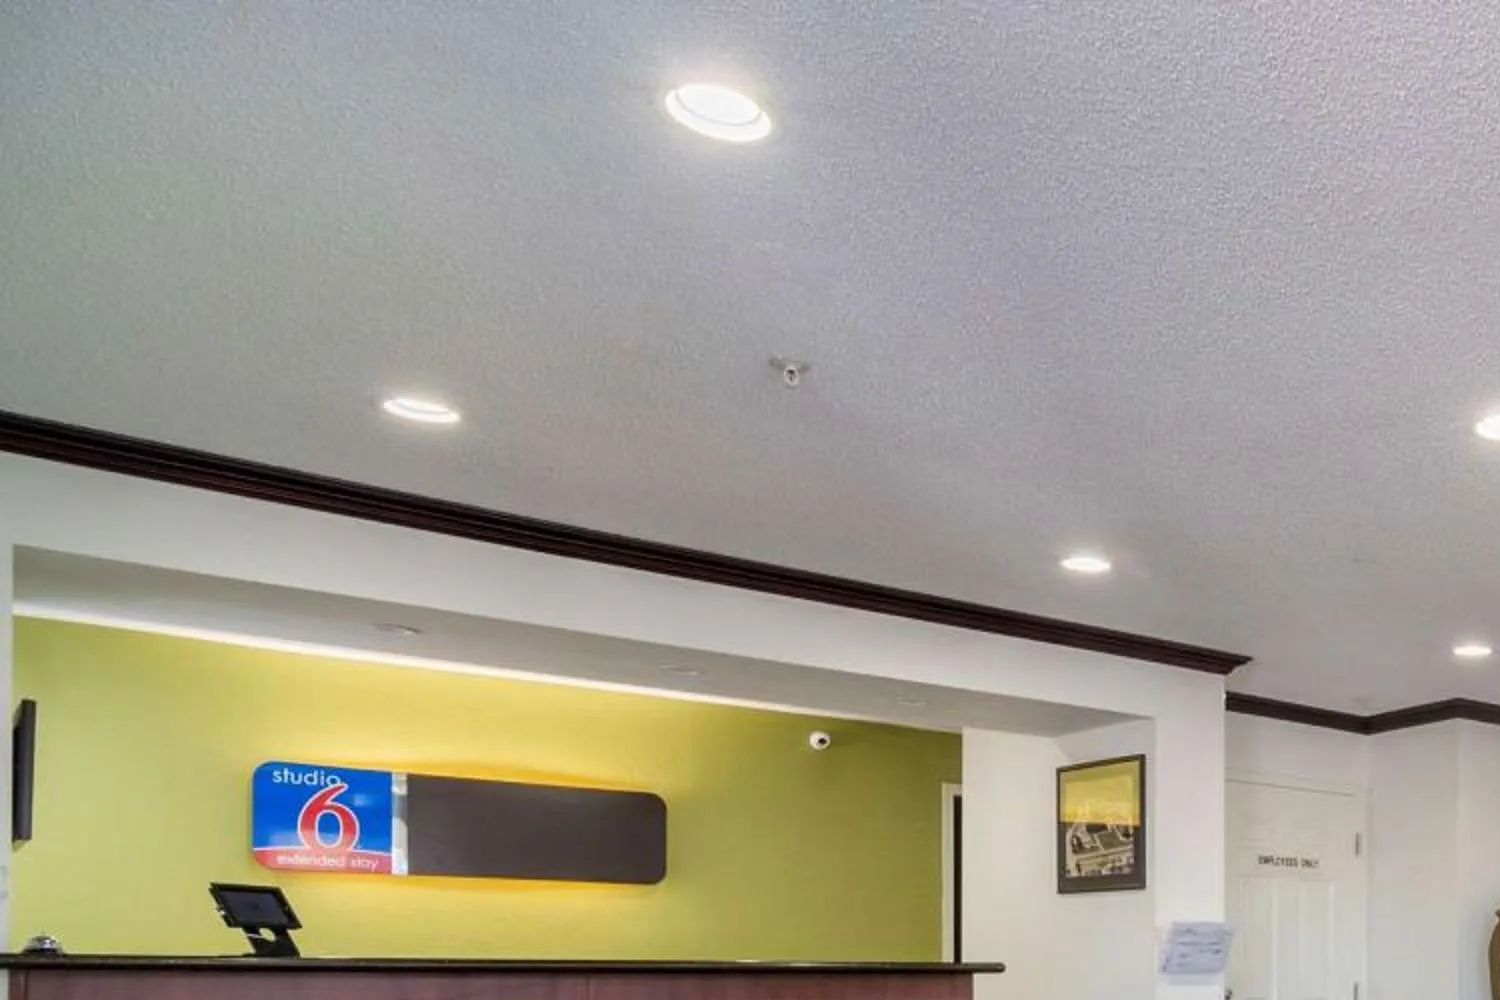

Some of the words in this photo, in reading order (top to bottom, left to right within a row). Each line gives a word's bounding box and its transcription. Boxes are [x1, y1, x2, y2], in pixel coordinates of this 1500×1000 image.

[272, 768, 341, 787] studio
[297, 782, 359, 851] 6
[277, 854, 345, 868] extended
[351, 856, 379, 872] stay
